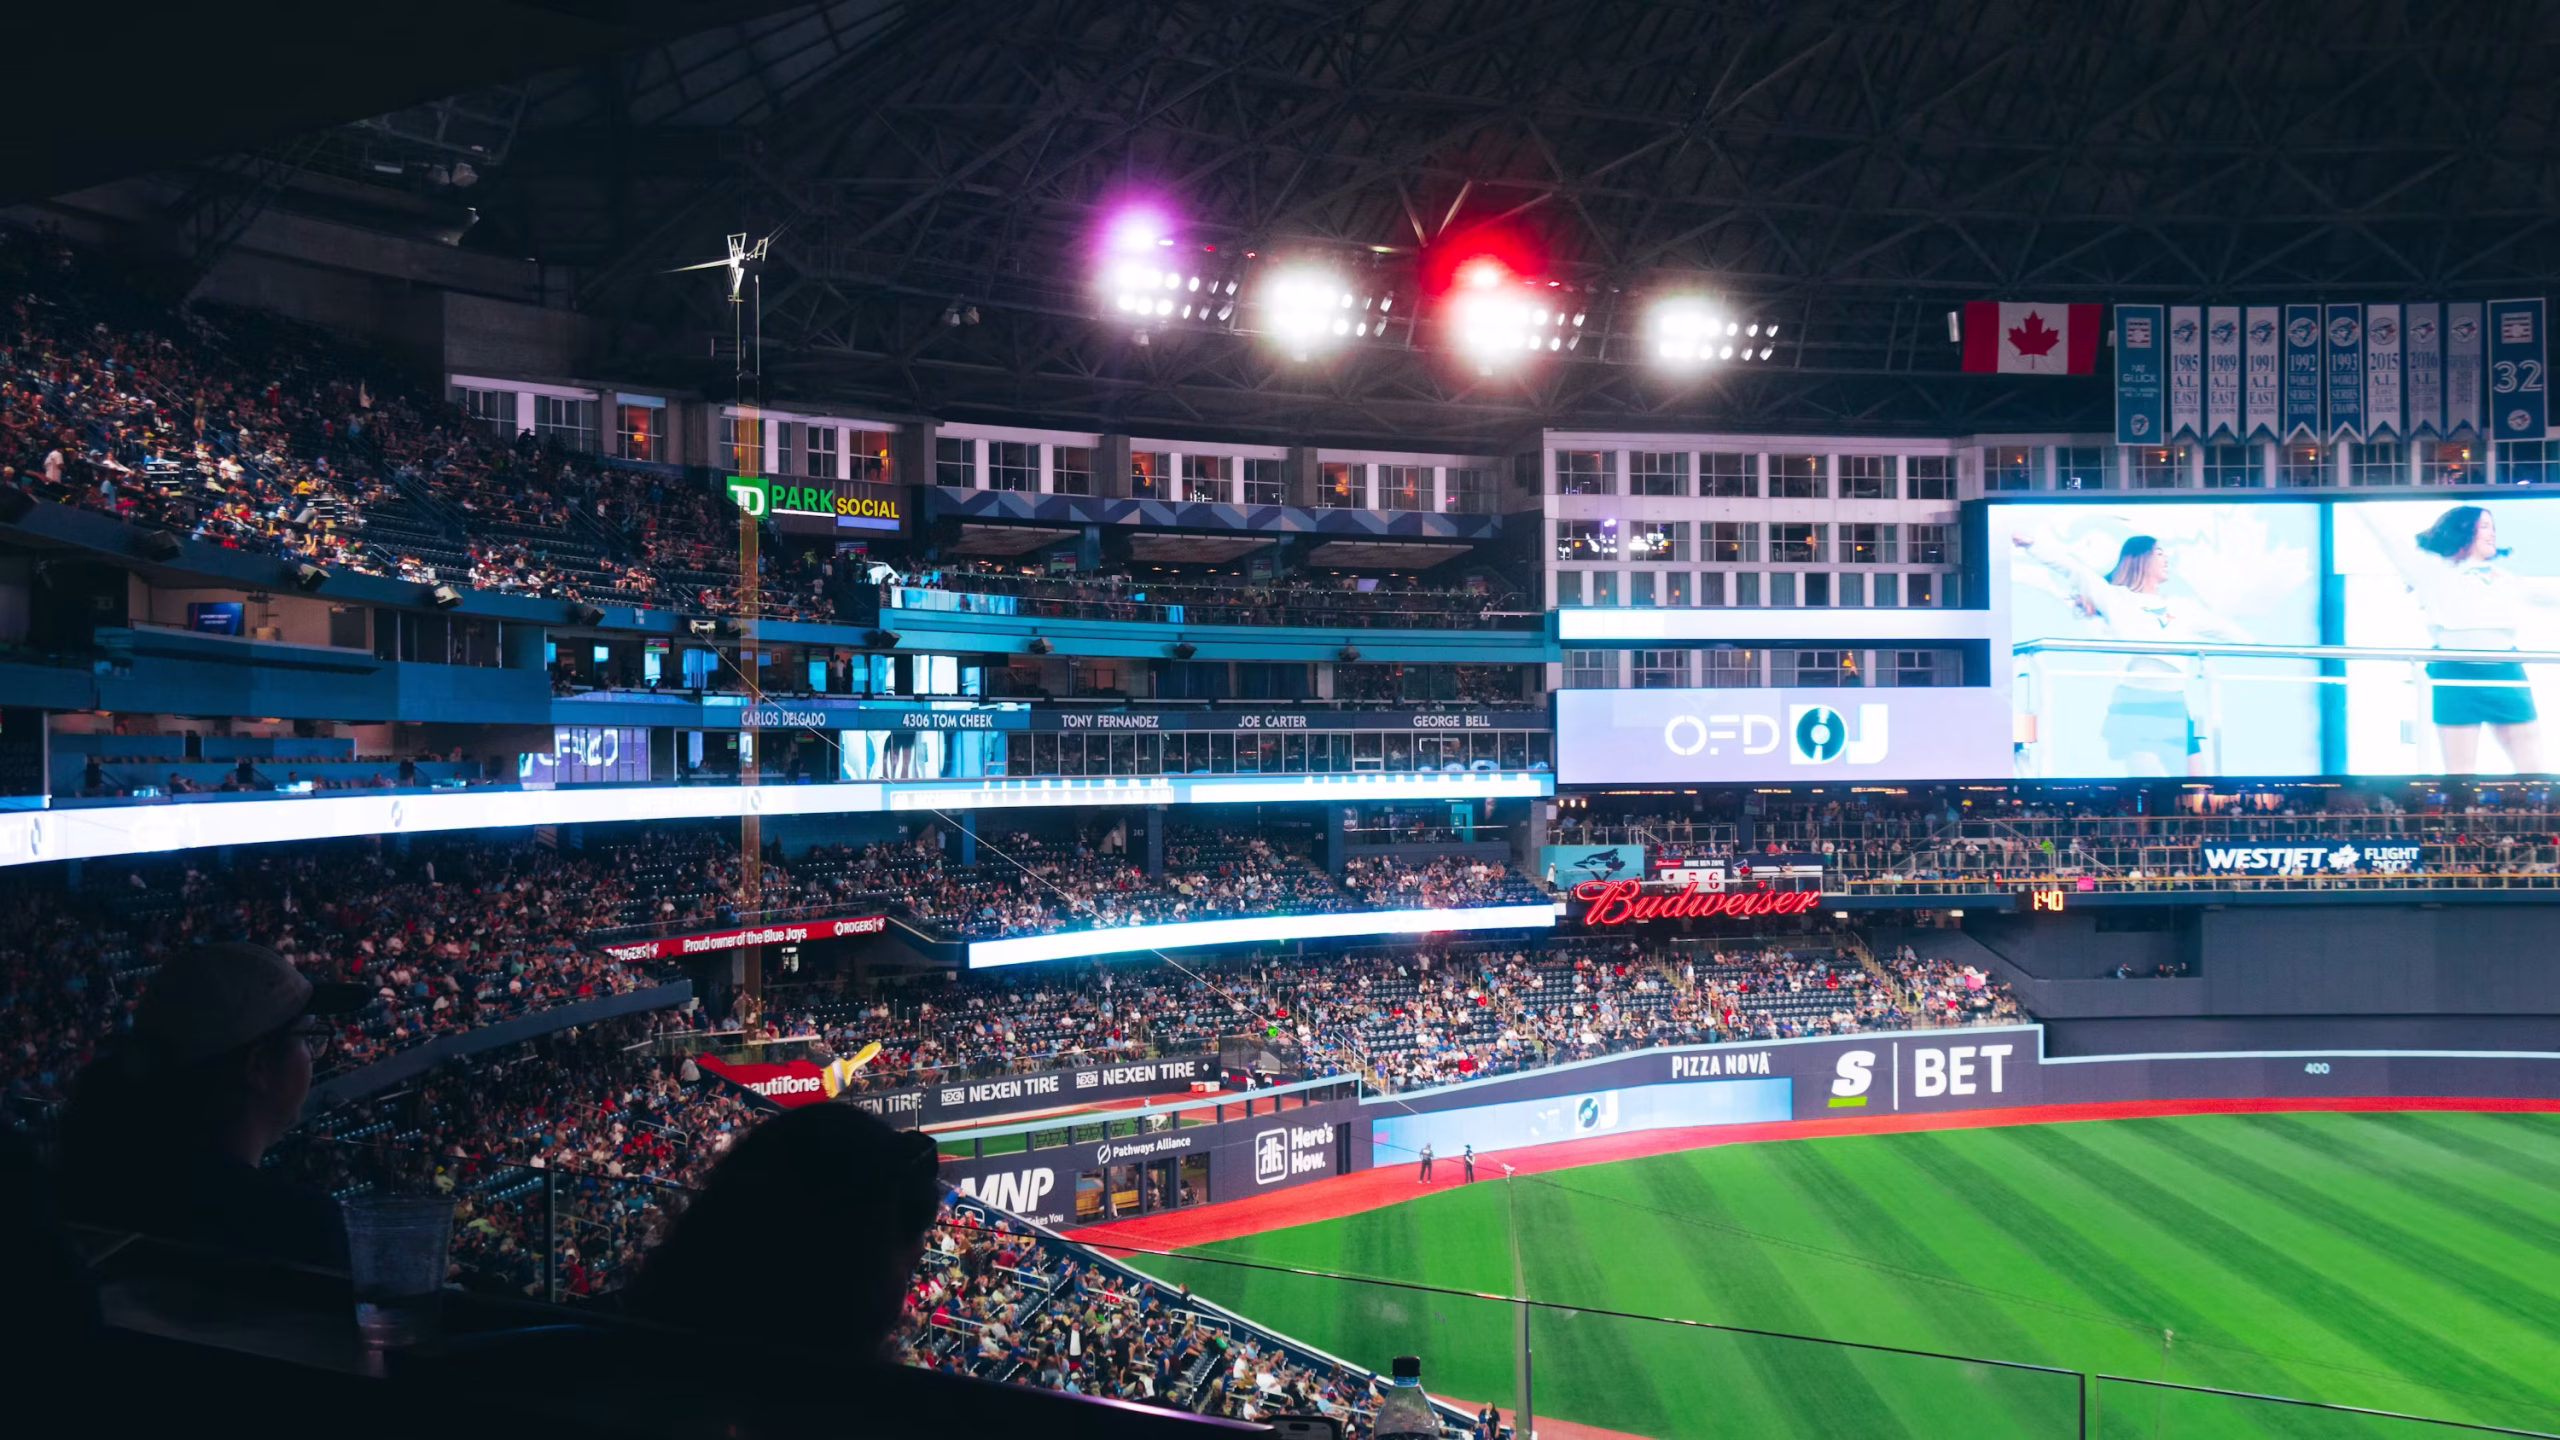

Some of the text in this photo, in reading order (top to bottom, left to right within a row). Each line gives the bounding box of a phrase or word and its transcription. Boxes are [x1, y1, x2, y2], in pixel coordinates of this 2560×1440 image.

[2174, 354, 2198, 372] 1985
[2211, 354, 2237, 372] 1989
[2250, 355, 2275, 372] 1991
[2290, 354, 2316, 371] 1992
[2331, 353, 2358, 371] 1993
[2370, 353, 2399, 371] 2015
[2175, 376, 2198, 388] A.L.
[2212, 376, 2237, 388] A.L.
[2251, 376, 2276, 388] A.L.
[2372, 374, 2396, 386] A.L.
[2493, 360, 2543, 393] 32
[2174, 391, 2198, 404] EAST
[2210, 391, 2236, 404] EAST
[2250, 391, 2275, 404] EAST
[730, 485, 899, 518] TD PARK SOCIAL
[741, 711, 826, 726] CARLOS DELGADO
[902, 713, 993, 728] 4306 TOM CHEEK
[1061, 715, 1159, 728] TONY FERNANDEZ
[1238, 715, 1307, 728] JOE CARTER
[1413, 715, 1490, 727] GEORGE BELL
[2204, 847, 2420, 873] WESTJET FLIGHT
[1576, 880, 1821, 926] Budweiser
[2034, 890, 2064, 911] 1:40
[684, 938, 710, 952] Proud
[711, 937, 736, 950] owner
[736, 933, 746, 947] of
[746, 931, 763, 945] the
[763, 928, 785, 943] Blue
[786, 927, 808, 943] Jays
[844, 920, 873, 934] ROGERS
[1103, 1065, 1156, 1086] NEXEN
[1159, 1061, 1195, 1079] TIRE
[1672, 1055, 1721, 1079] PIZZA
[1915, 1044, 2013, 1097] BET
[2305, 1063, 2330, 1075] 400
[969, 1081, 1021, 1102] NEXEN
[1026, 1076, 1059, 1095] TIRE
[1291, 1122, 1334, 1150] Here's
[1113, 1137, 1191, 1158] Pathways Alliance
[1291, 1150, 1326, 1174] How.
[960, 1167, 1054, 1214] MNP
[1049, 1213, 1064, 1223] You
